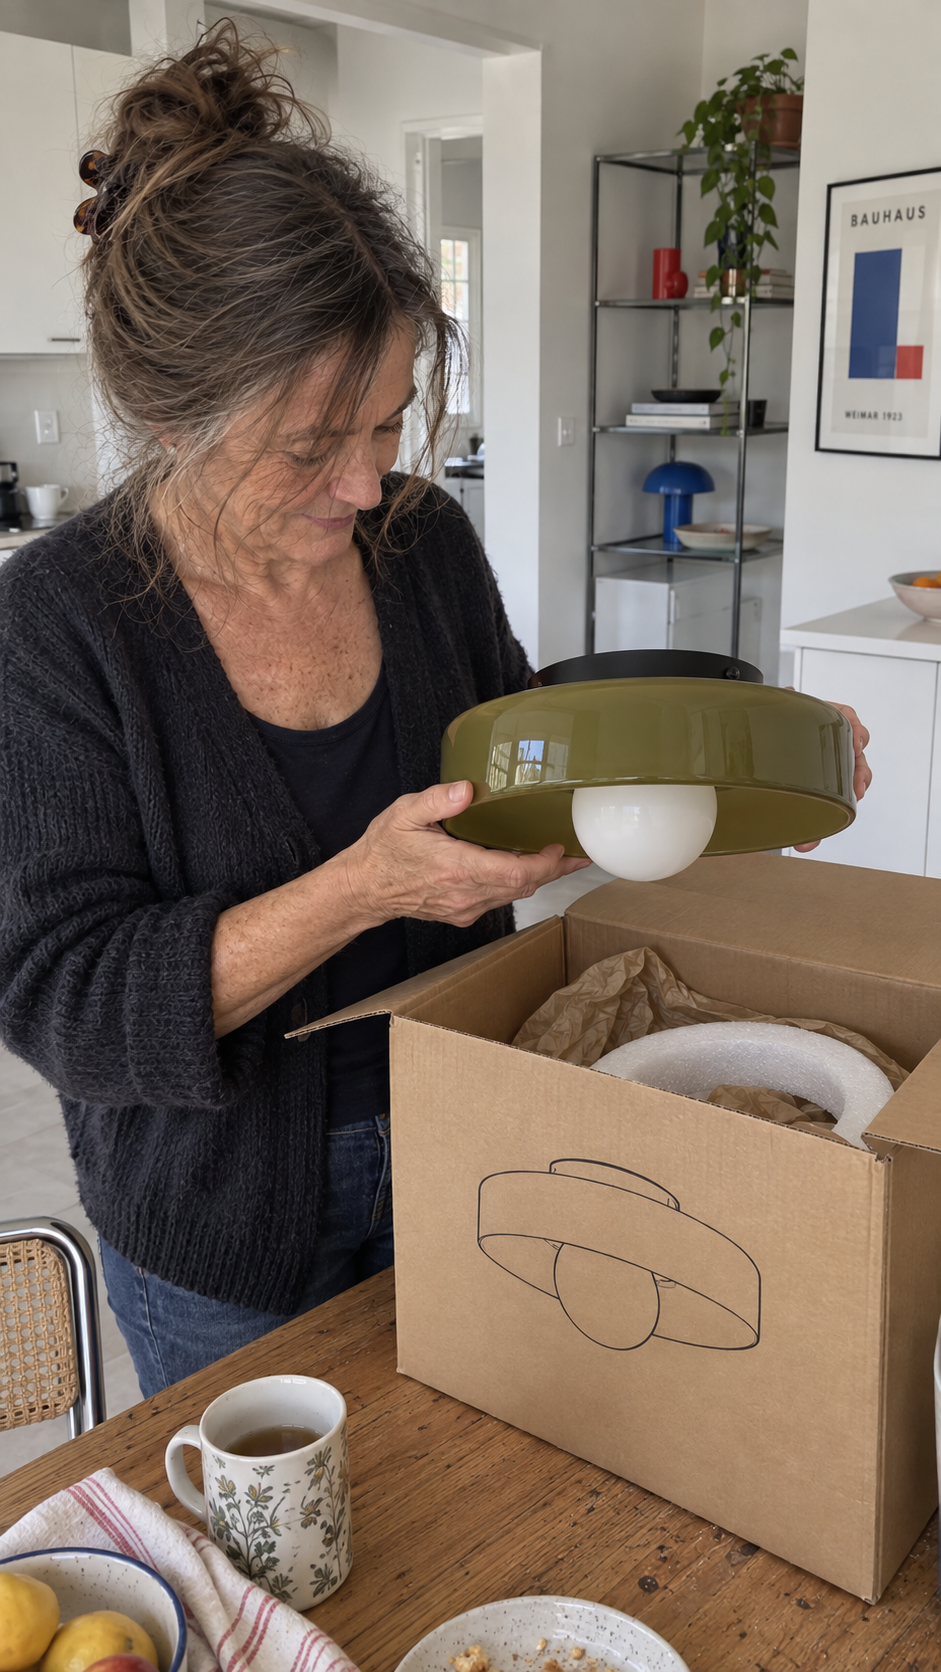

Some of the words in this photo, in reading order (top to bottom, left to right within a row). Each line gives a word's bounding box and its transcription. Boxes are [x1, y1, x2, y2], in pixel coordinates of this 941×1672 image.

[851, 205, 926, 228] BAUHAUS
[845, 410, 878, 420] WEIMAR
[883, 411, 903, 421] 1923
